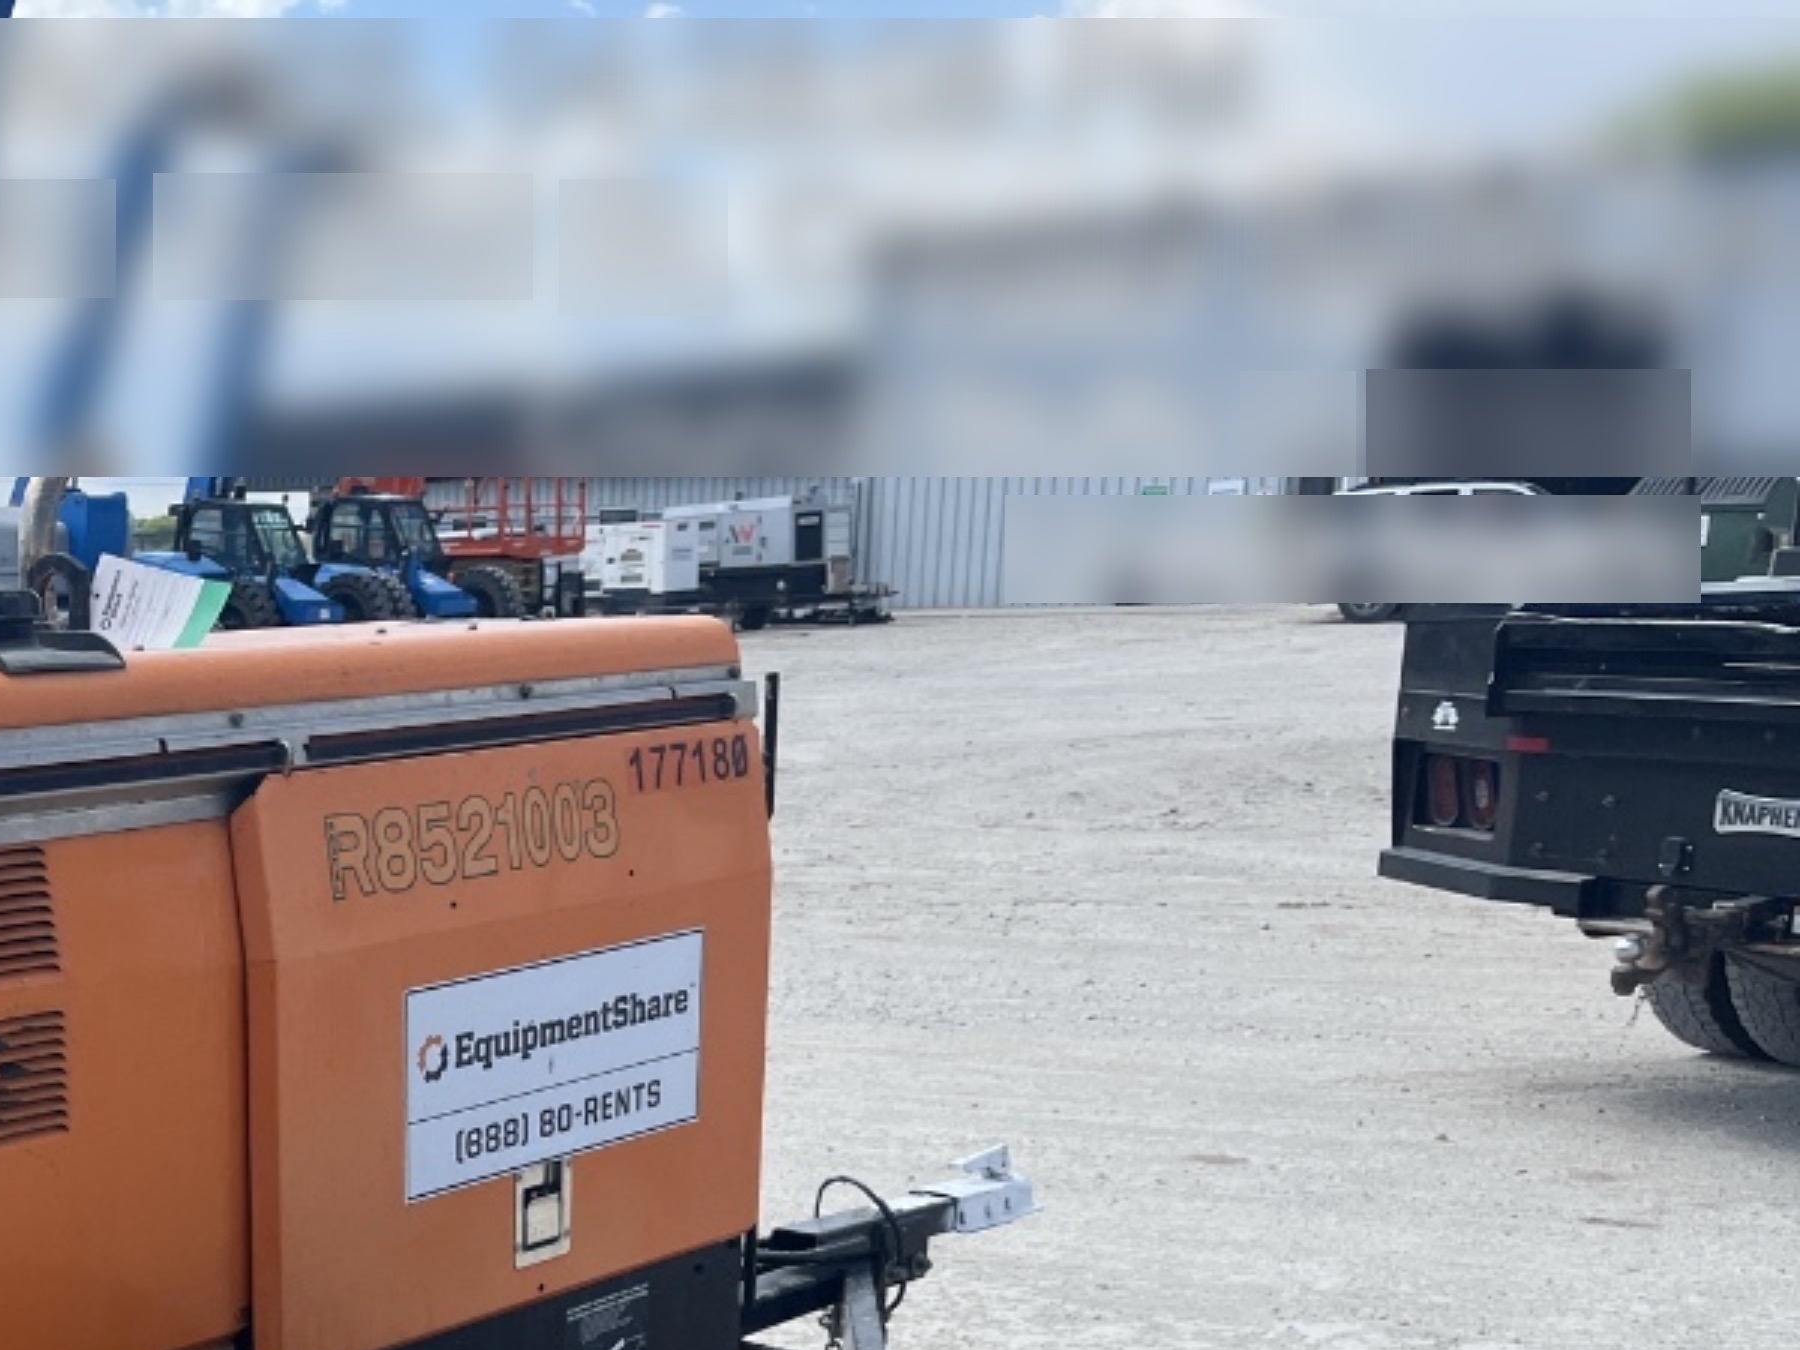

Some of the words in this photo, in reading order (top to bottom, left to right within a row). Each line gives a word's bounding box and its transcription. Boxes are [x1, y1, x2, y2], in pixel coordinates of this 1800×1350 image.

[627, 733, 749, 793] 177180
[323, 776, 620, 901] R8521003
[454, 988, 690, 1071] EquipmentShare
[455, 1112, 530, 1164] (888)
[539, 1078, 662, 1139] 80-RENTS
